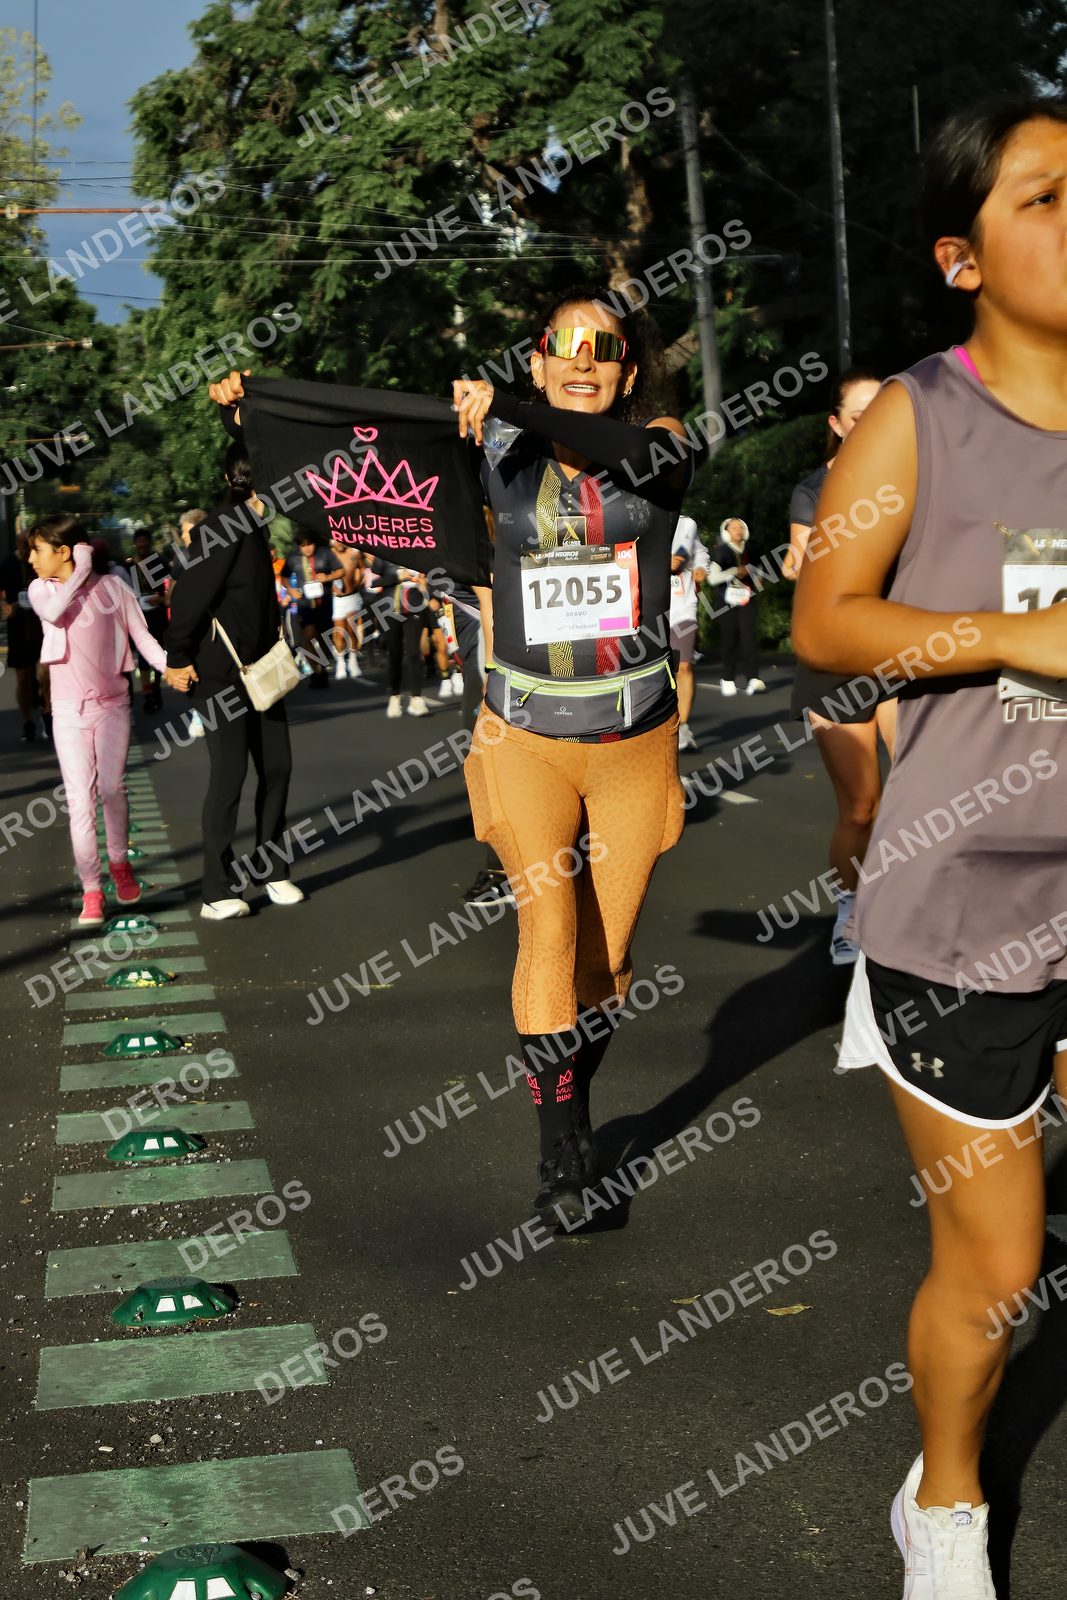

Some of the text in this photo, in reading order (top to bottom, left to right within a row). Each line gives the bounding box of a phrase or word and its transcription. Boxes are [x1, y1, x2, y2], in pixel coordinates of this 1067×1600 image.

[328, 515, 434, 534] MUJERES
[331, 530, 437, 549] RUNNERAS
[528, 575, 622, 610] 12055
